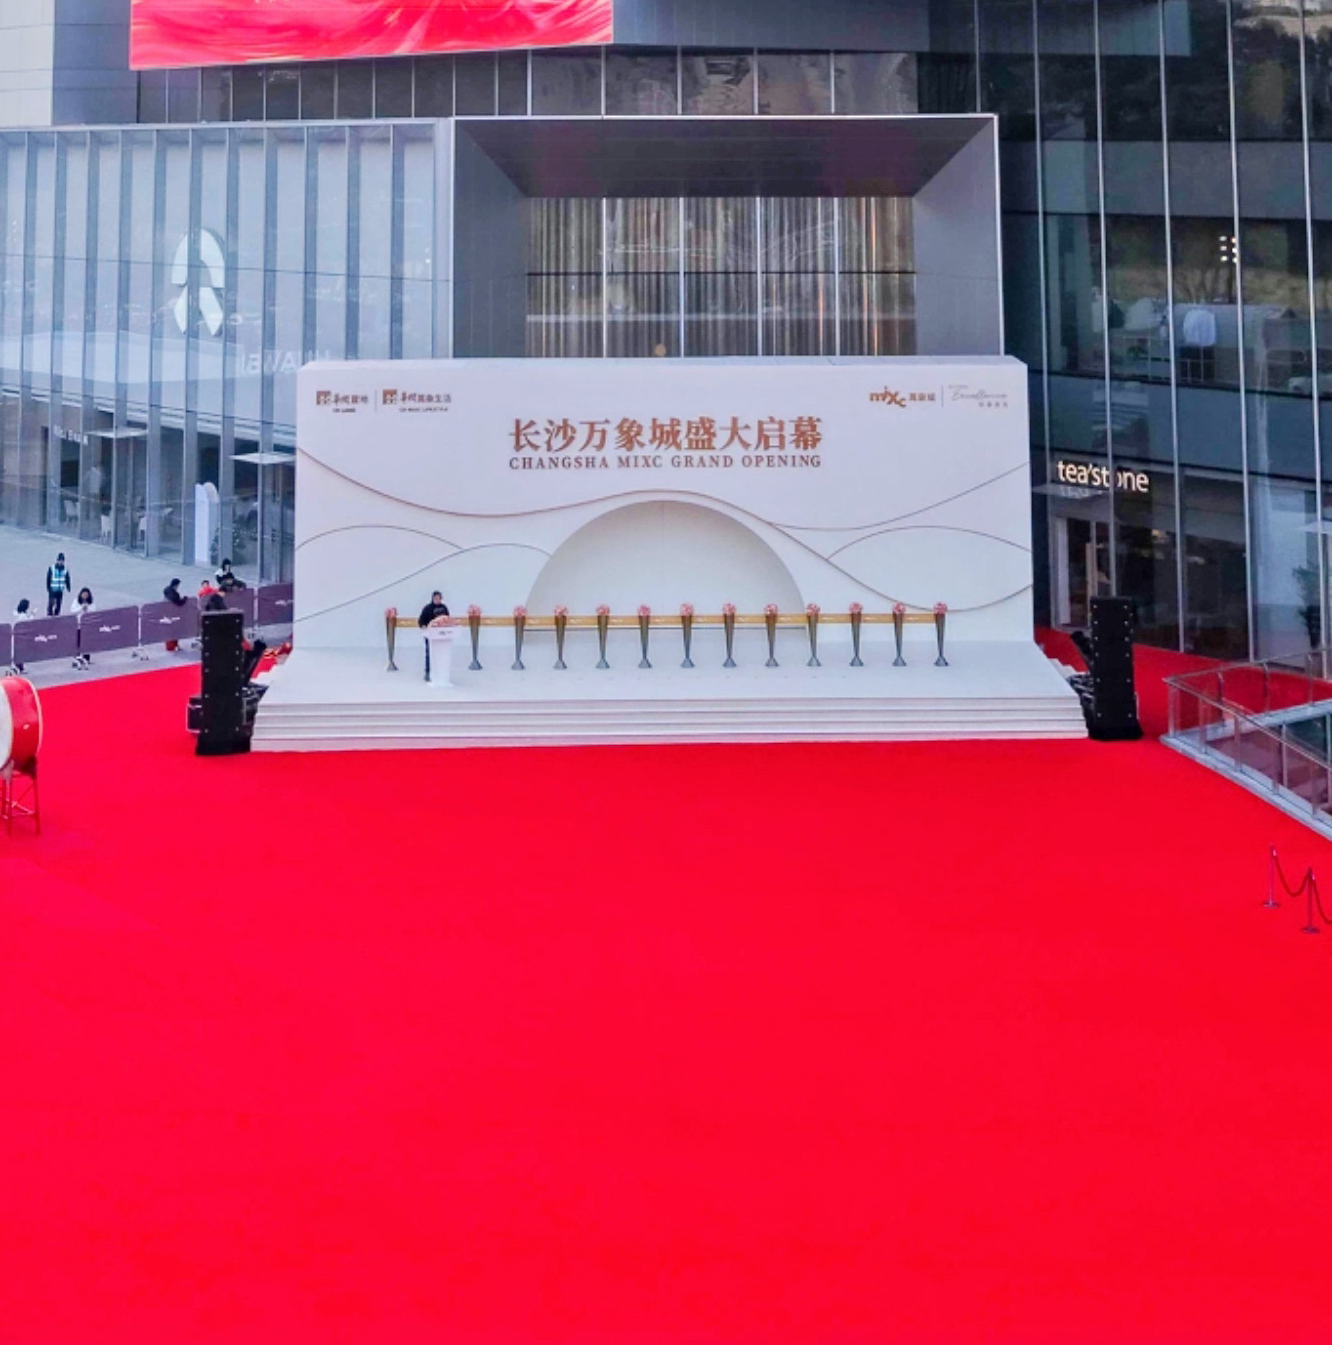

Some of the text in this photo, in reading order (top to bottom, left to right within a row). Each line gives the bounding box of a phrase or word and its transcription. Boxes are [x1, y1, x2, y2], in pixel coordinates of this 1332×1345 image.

[509, 415, 823, 453] 长沙万象城盛大启幕
[509, 454, 822, 470] CHANGSHA MIXC GRAND OPENING
